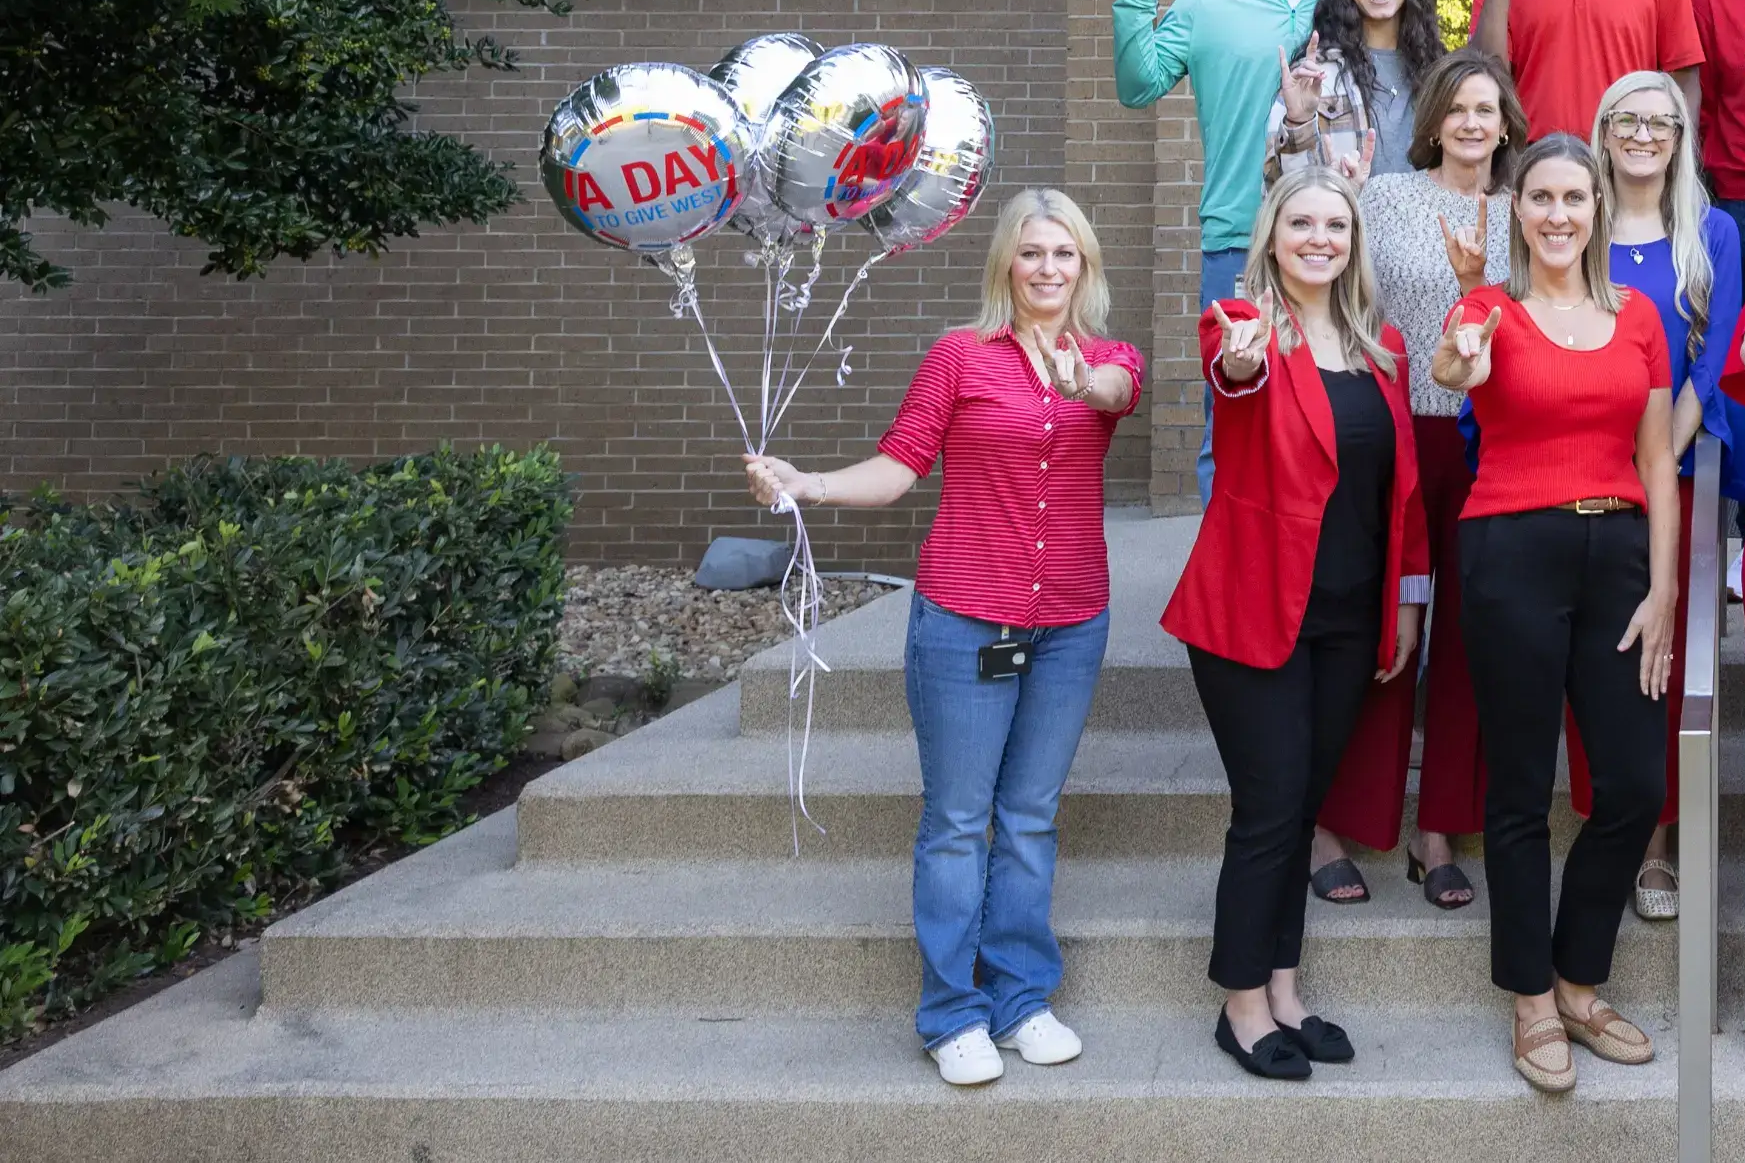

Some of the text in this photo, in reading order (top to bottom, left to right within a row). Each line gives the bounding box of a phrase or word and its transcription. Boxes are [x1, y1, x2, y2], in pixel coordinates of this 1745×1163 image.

[577, 141, 720, 212] A DAY
[594, 185, 723, 229] TO GIVE WEST
